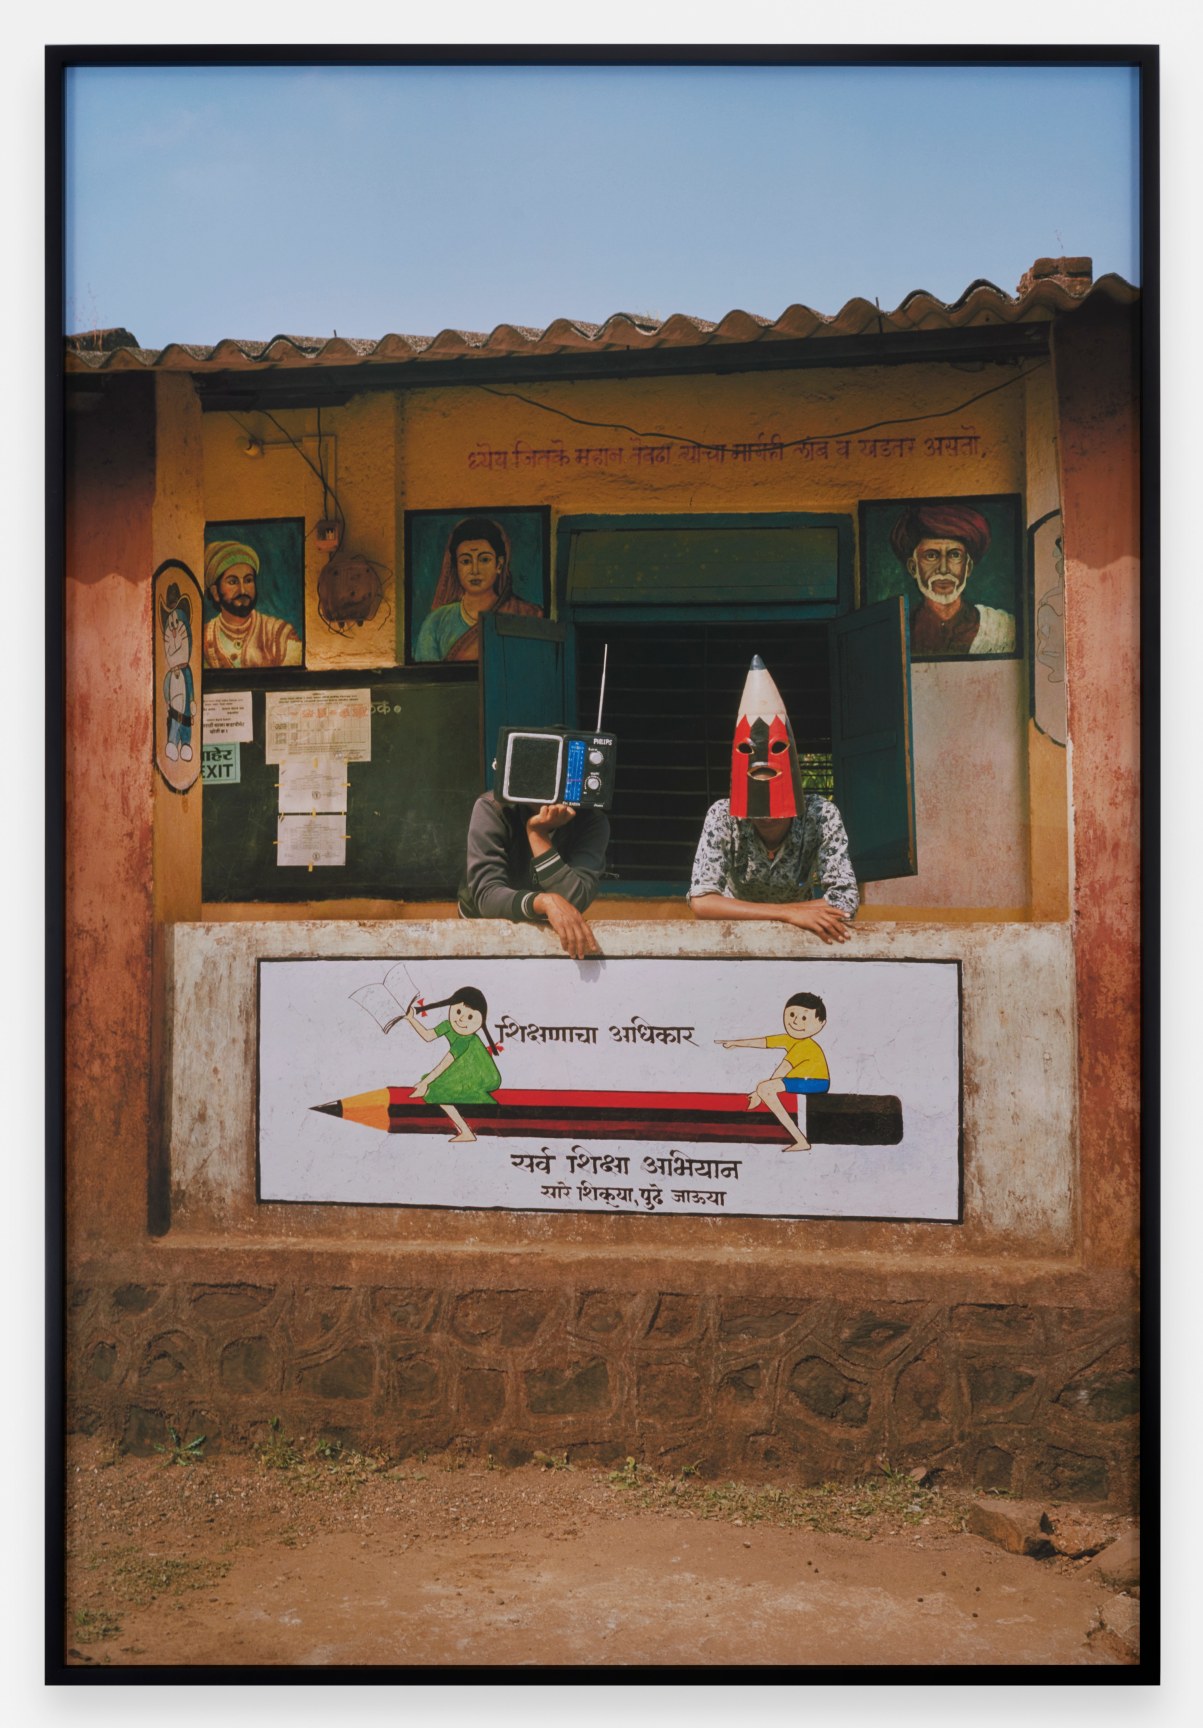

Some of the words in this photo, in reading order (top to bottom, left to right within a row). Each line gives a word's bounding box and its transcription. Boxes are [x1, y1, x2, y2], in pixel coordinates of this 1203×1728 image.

[593, 738, 613, 746] PHILIPS
[495, 1015, 599, 1045] शिक्षणाचा
[608, 1016, 700, 1047] अधिकार
[510, 1147, 556, 1174] सर्व
[566, 1145, 630, 1175] शिक्षा
[643, 1150, 742, 1179] अभियान
[541, 1181, 572, 1199] सारे
[671, 1190, 727, 1206] जाऊया
